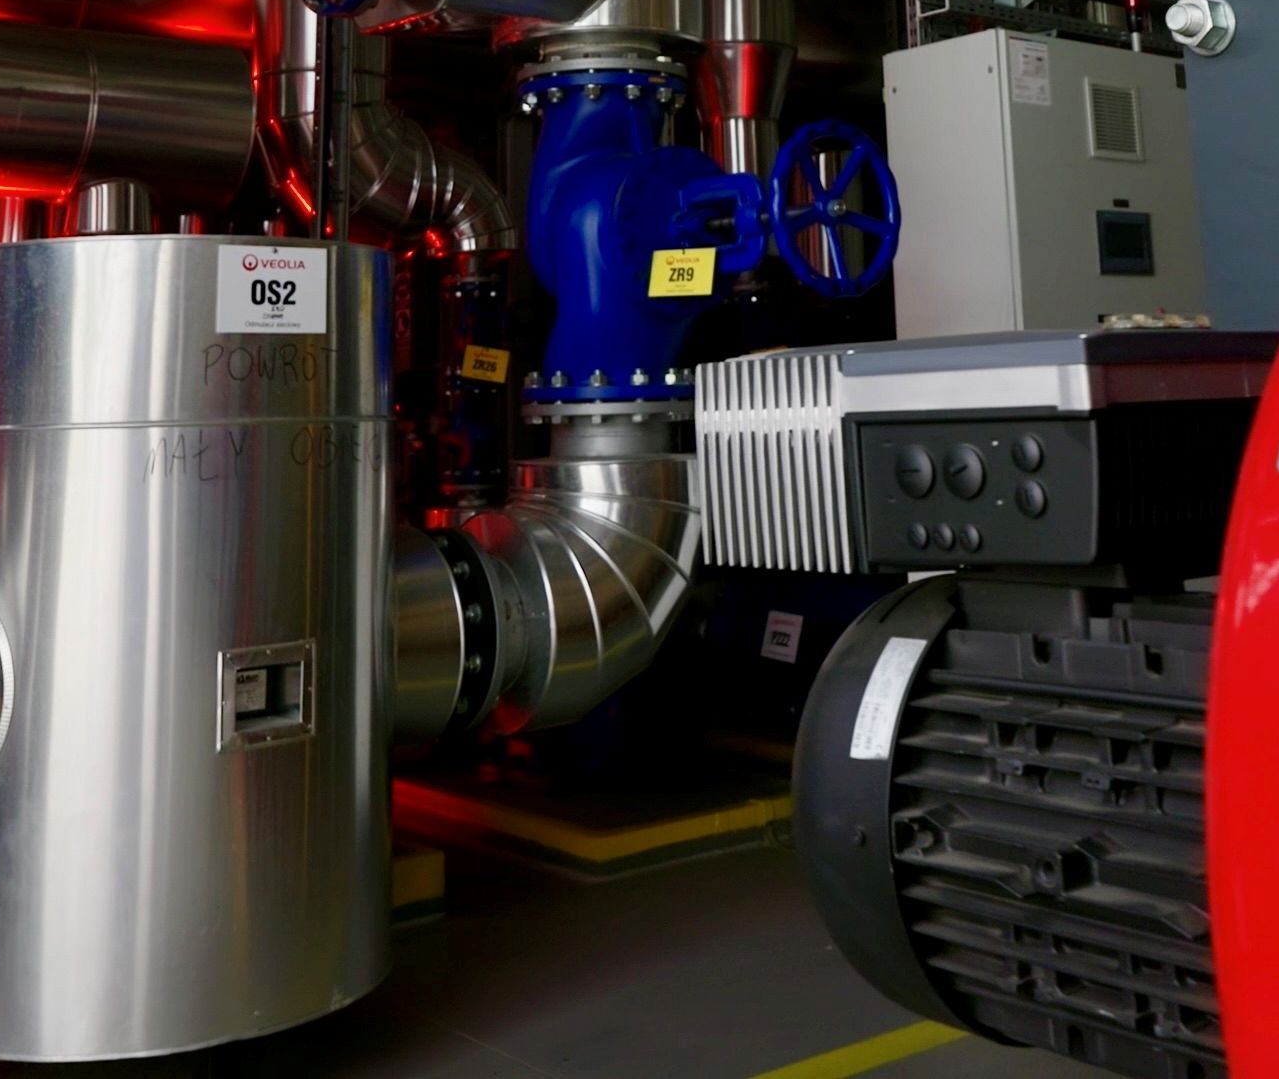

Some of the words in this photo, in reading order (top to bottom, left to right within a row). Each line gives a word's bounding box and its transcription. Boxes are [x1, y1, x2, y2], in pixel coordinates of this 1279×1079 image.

[260, 259, 306, 270] VEOLIA
[668, 267, 695, 282] ZR9
[250, 279, 297, 306] OS2
